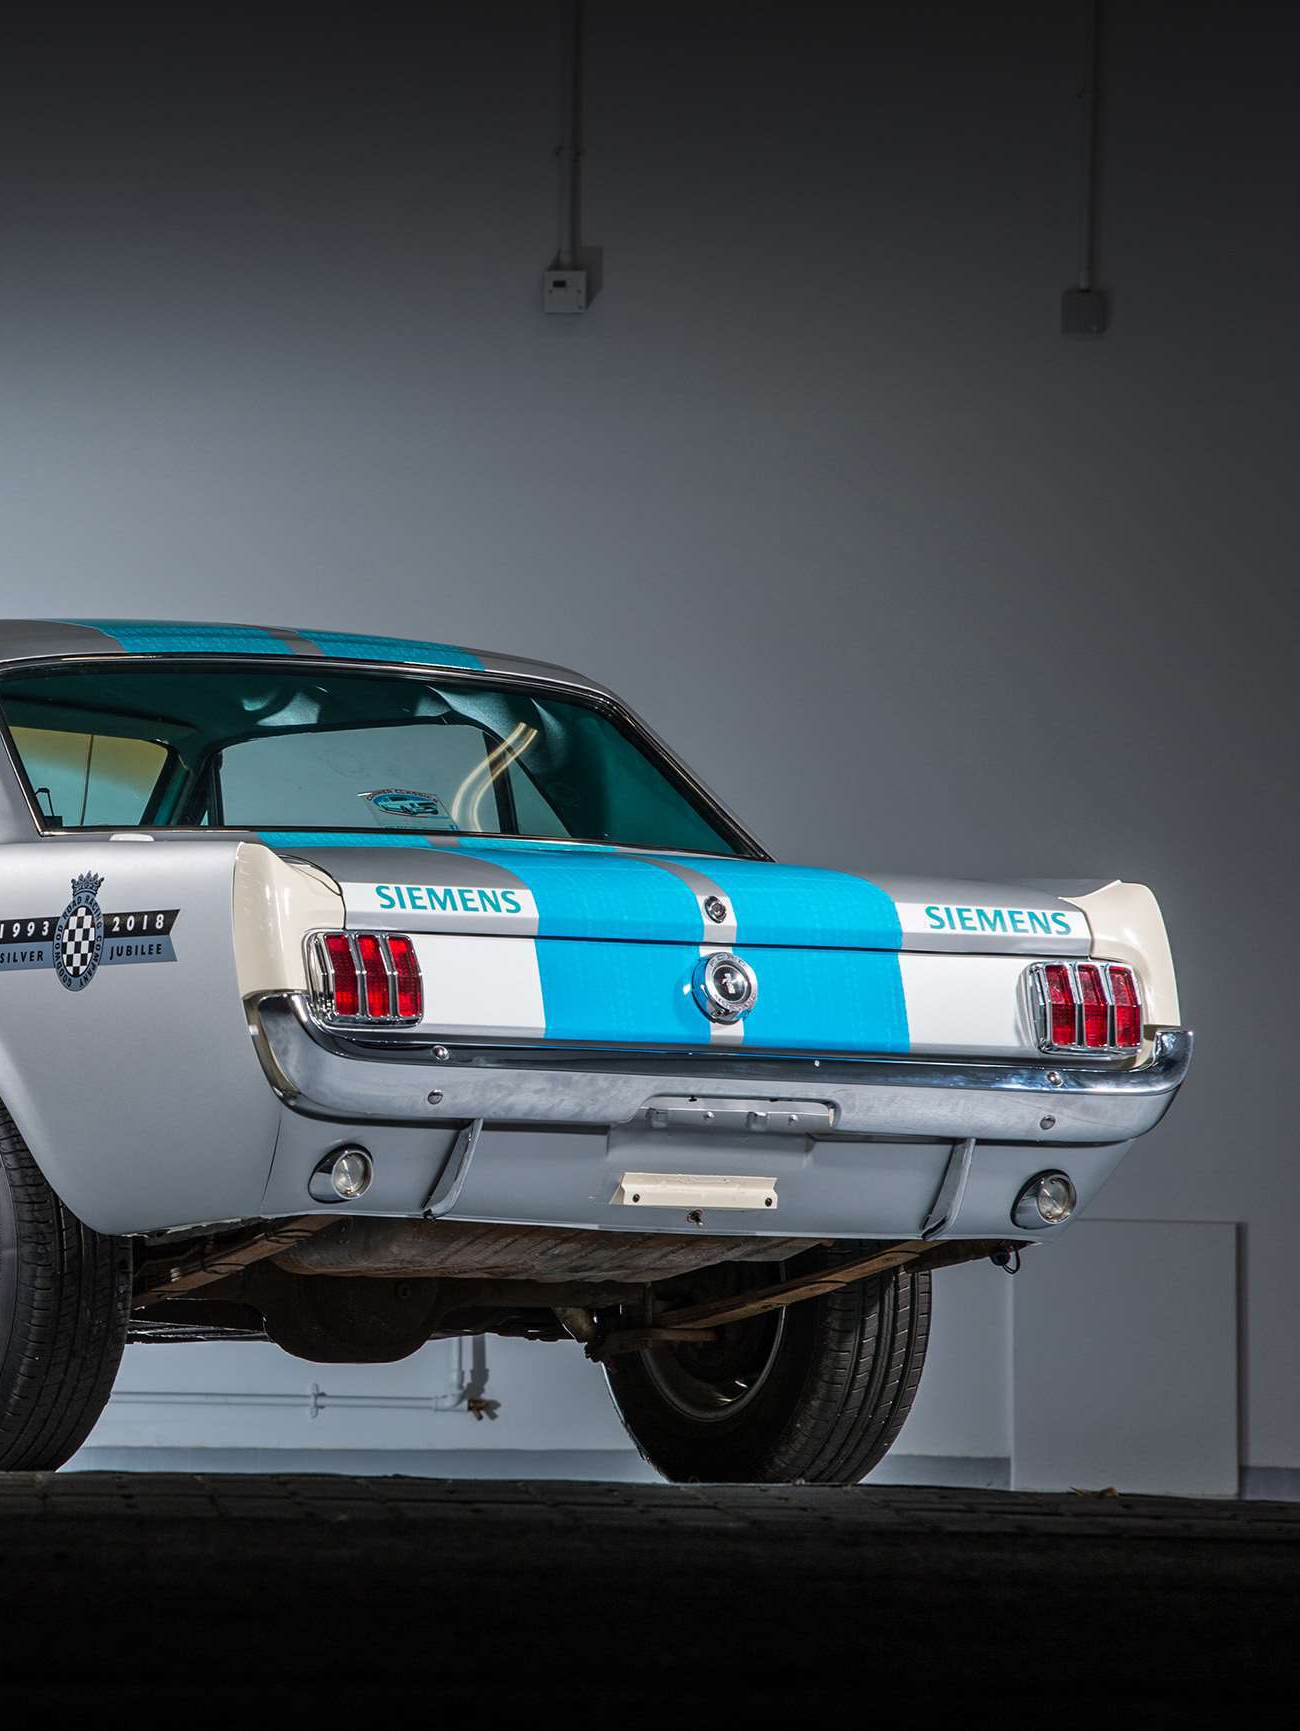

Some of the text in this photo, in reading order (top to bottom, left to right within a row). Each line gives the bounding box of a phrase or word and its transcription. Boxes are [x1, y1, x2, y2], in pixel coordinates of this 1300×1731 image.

[375, 885, 522, 914] SIEMENS
[0, 914, 165, 939] 1993 2018
[924, 905, 1072, 936] SIEMENS
[0, 943, 162, 964] SILVER JUBILEE
[54, 895, 102, 988] GOODWOOD ROAD RACING COMPANY
